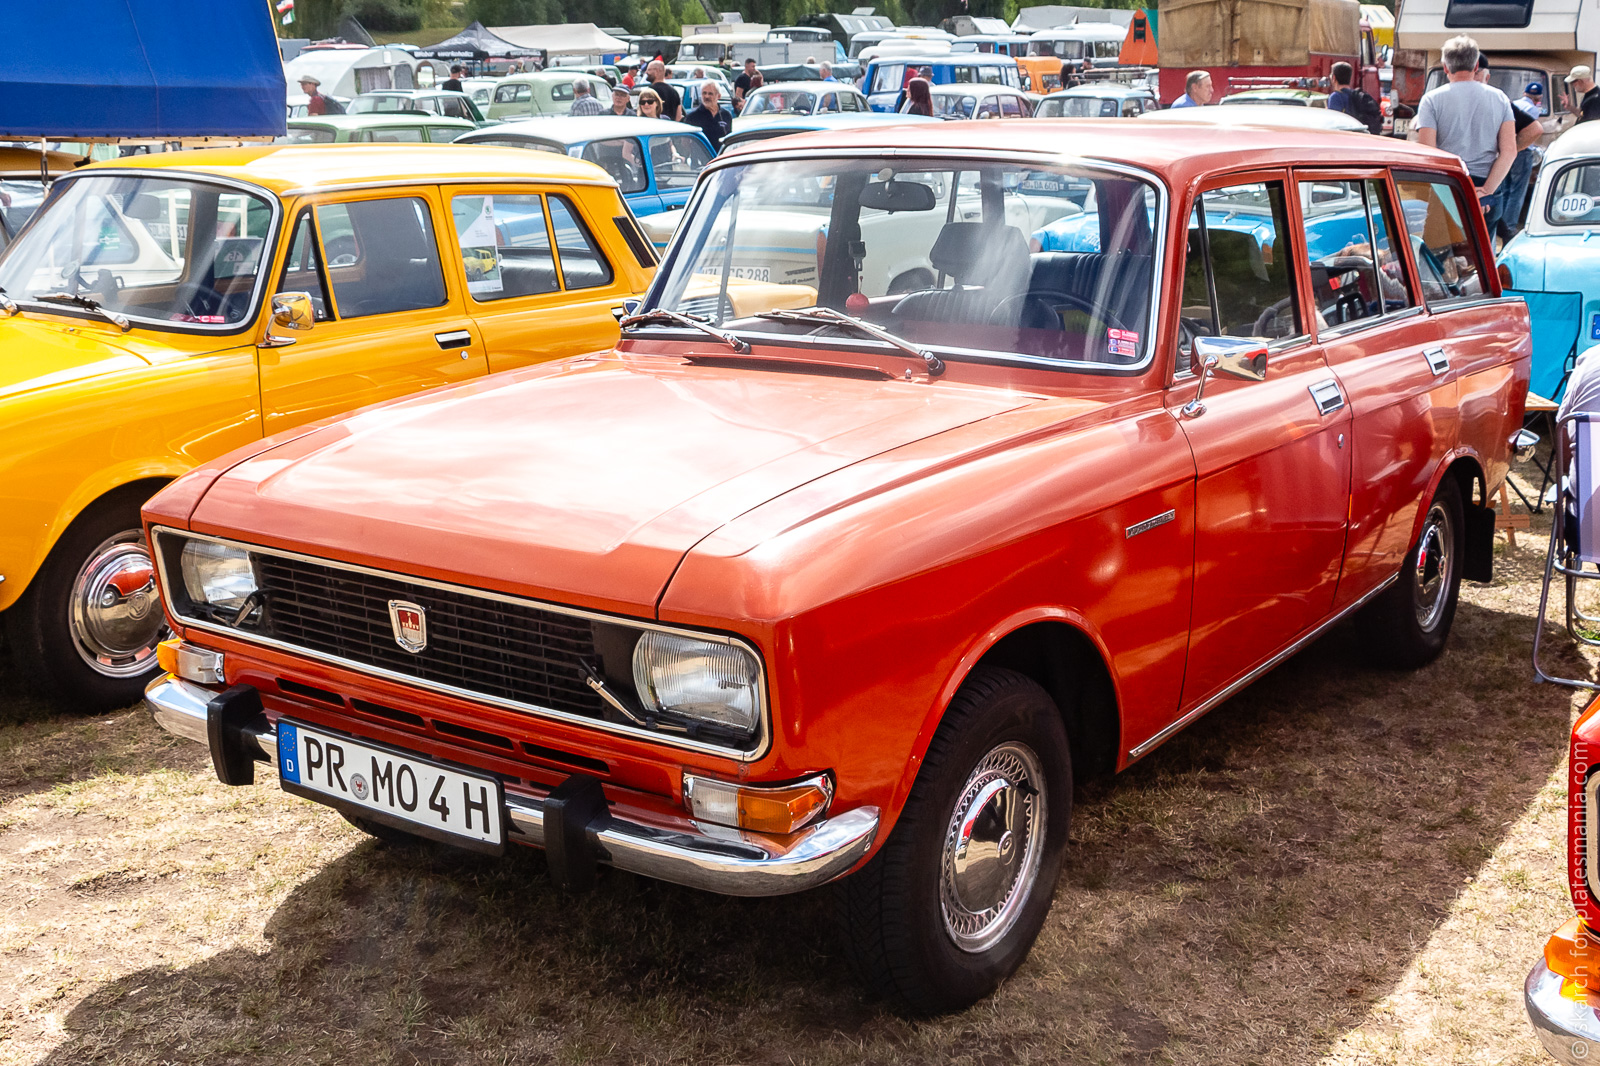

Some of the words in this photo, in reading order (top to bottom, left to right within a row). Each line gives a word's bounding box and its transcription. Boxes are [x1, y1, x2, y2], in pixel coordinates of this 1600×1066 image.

[1562, 198, 1588, 212] DDR
[286, 758, 294, 773] D
[303, 735, 348, 793] PR
[371, 756, 419, 813] MO
[428, 775, 450, 823] 4
[462, 781, 490, 835] H
